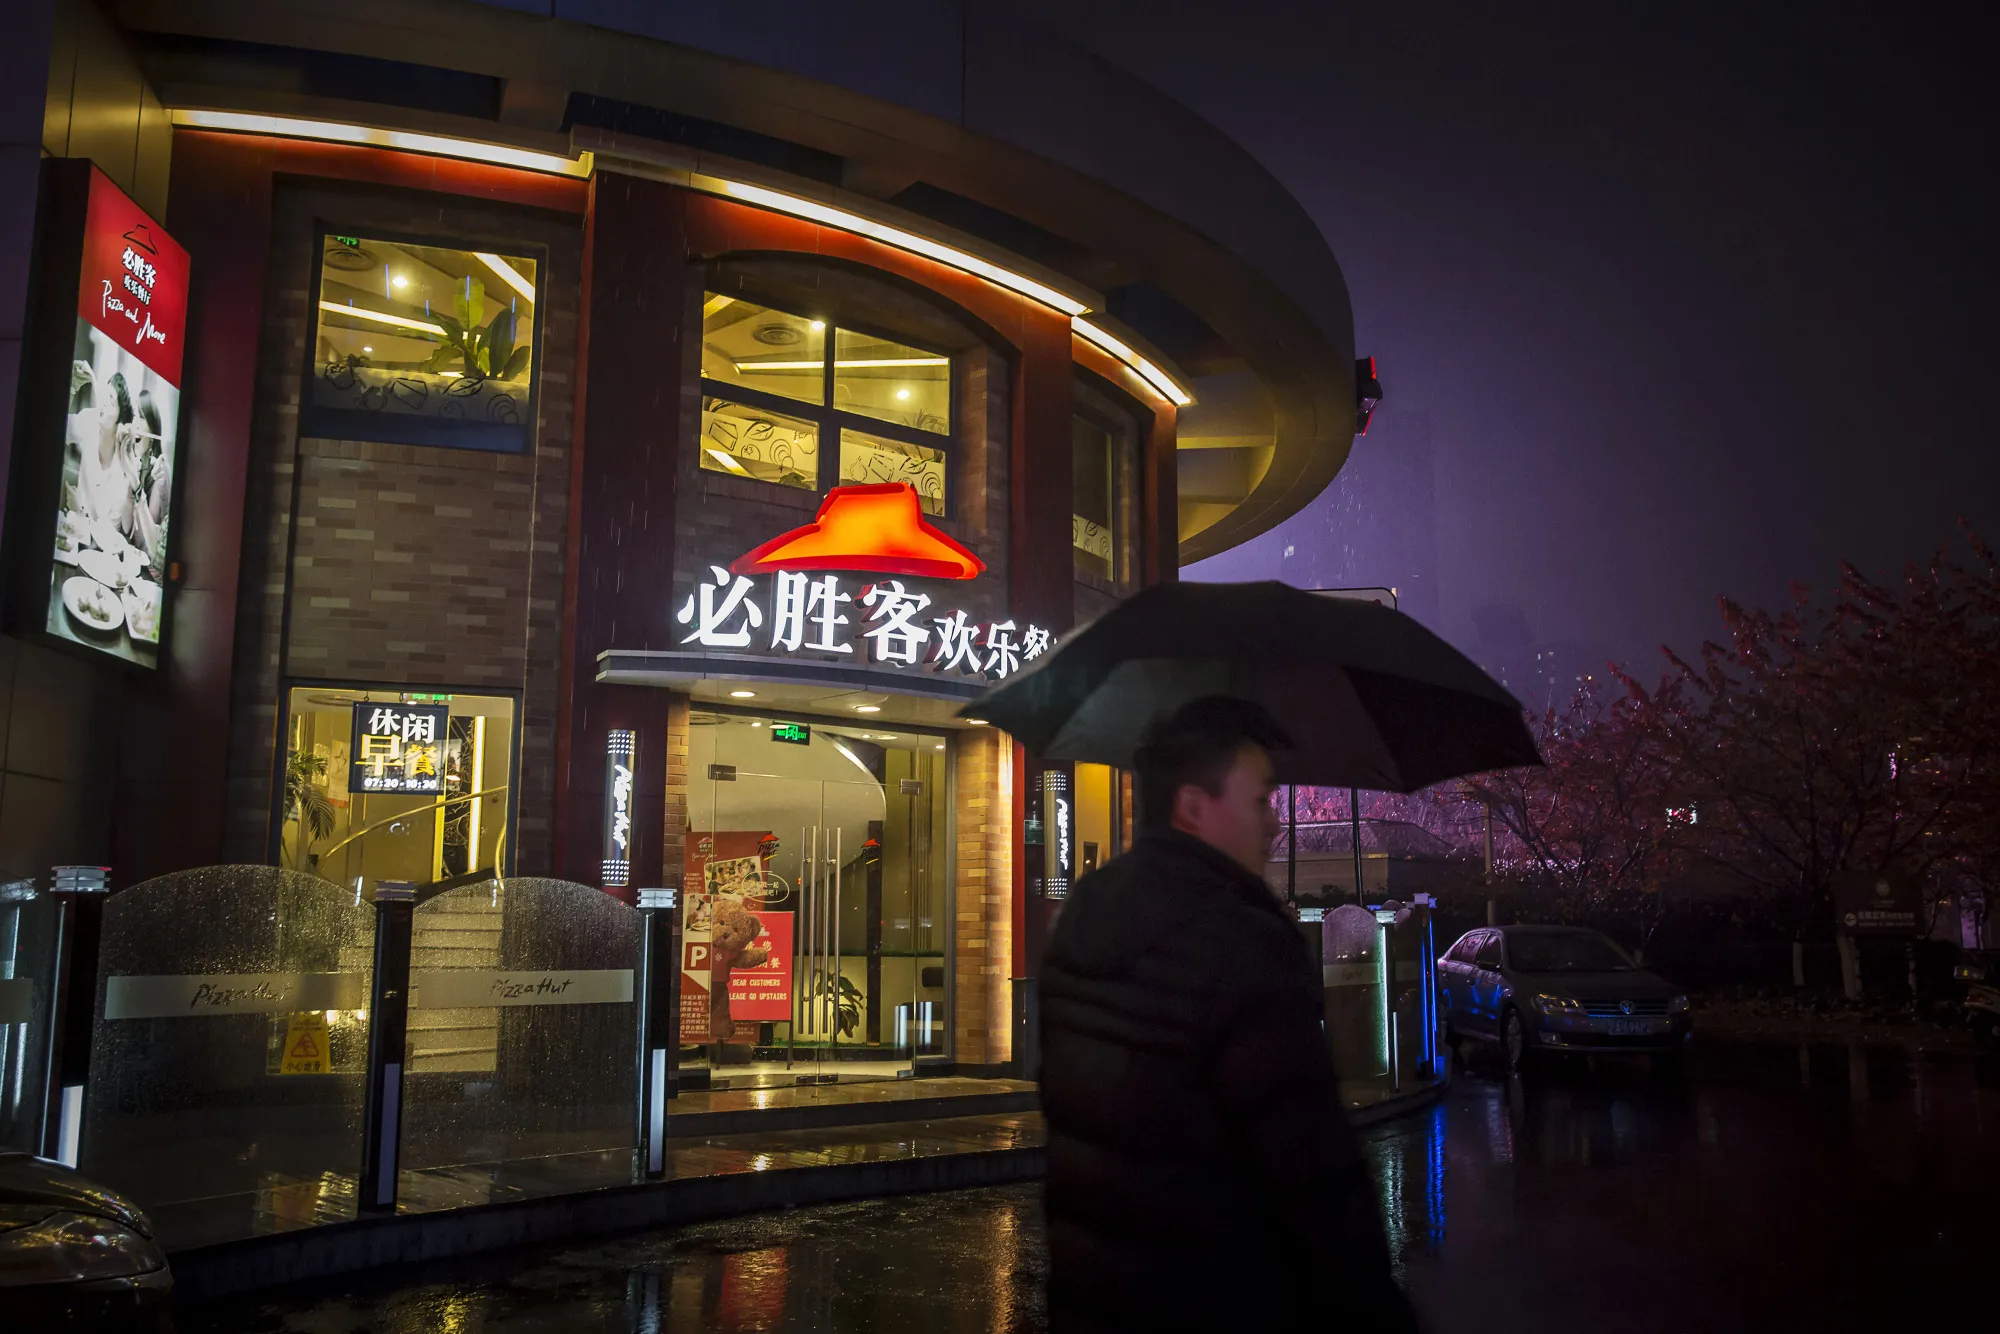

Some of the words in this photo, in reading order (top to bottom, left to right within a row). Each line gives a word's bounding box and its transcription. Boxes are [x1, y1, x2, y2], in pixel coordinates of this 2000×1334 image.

[101, 279, 124, 318] Pizza
[125, 307, 139, 324] and
[136, 311, 166, 345] More
[368, 707, 436, 744] 休闲
[355, 734, 438, 776] 早餐
[691, 946, 708, 967] P
[729, 992, 746, 1000] LEASE
[749, 992, 757, 1000] GO
[759, 992, 788, 1000] UPSTAIRS
[749, 979, 781, 987] CUSTOMERS
